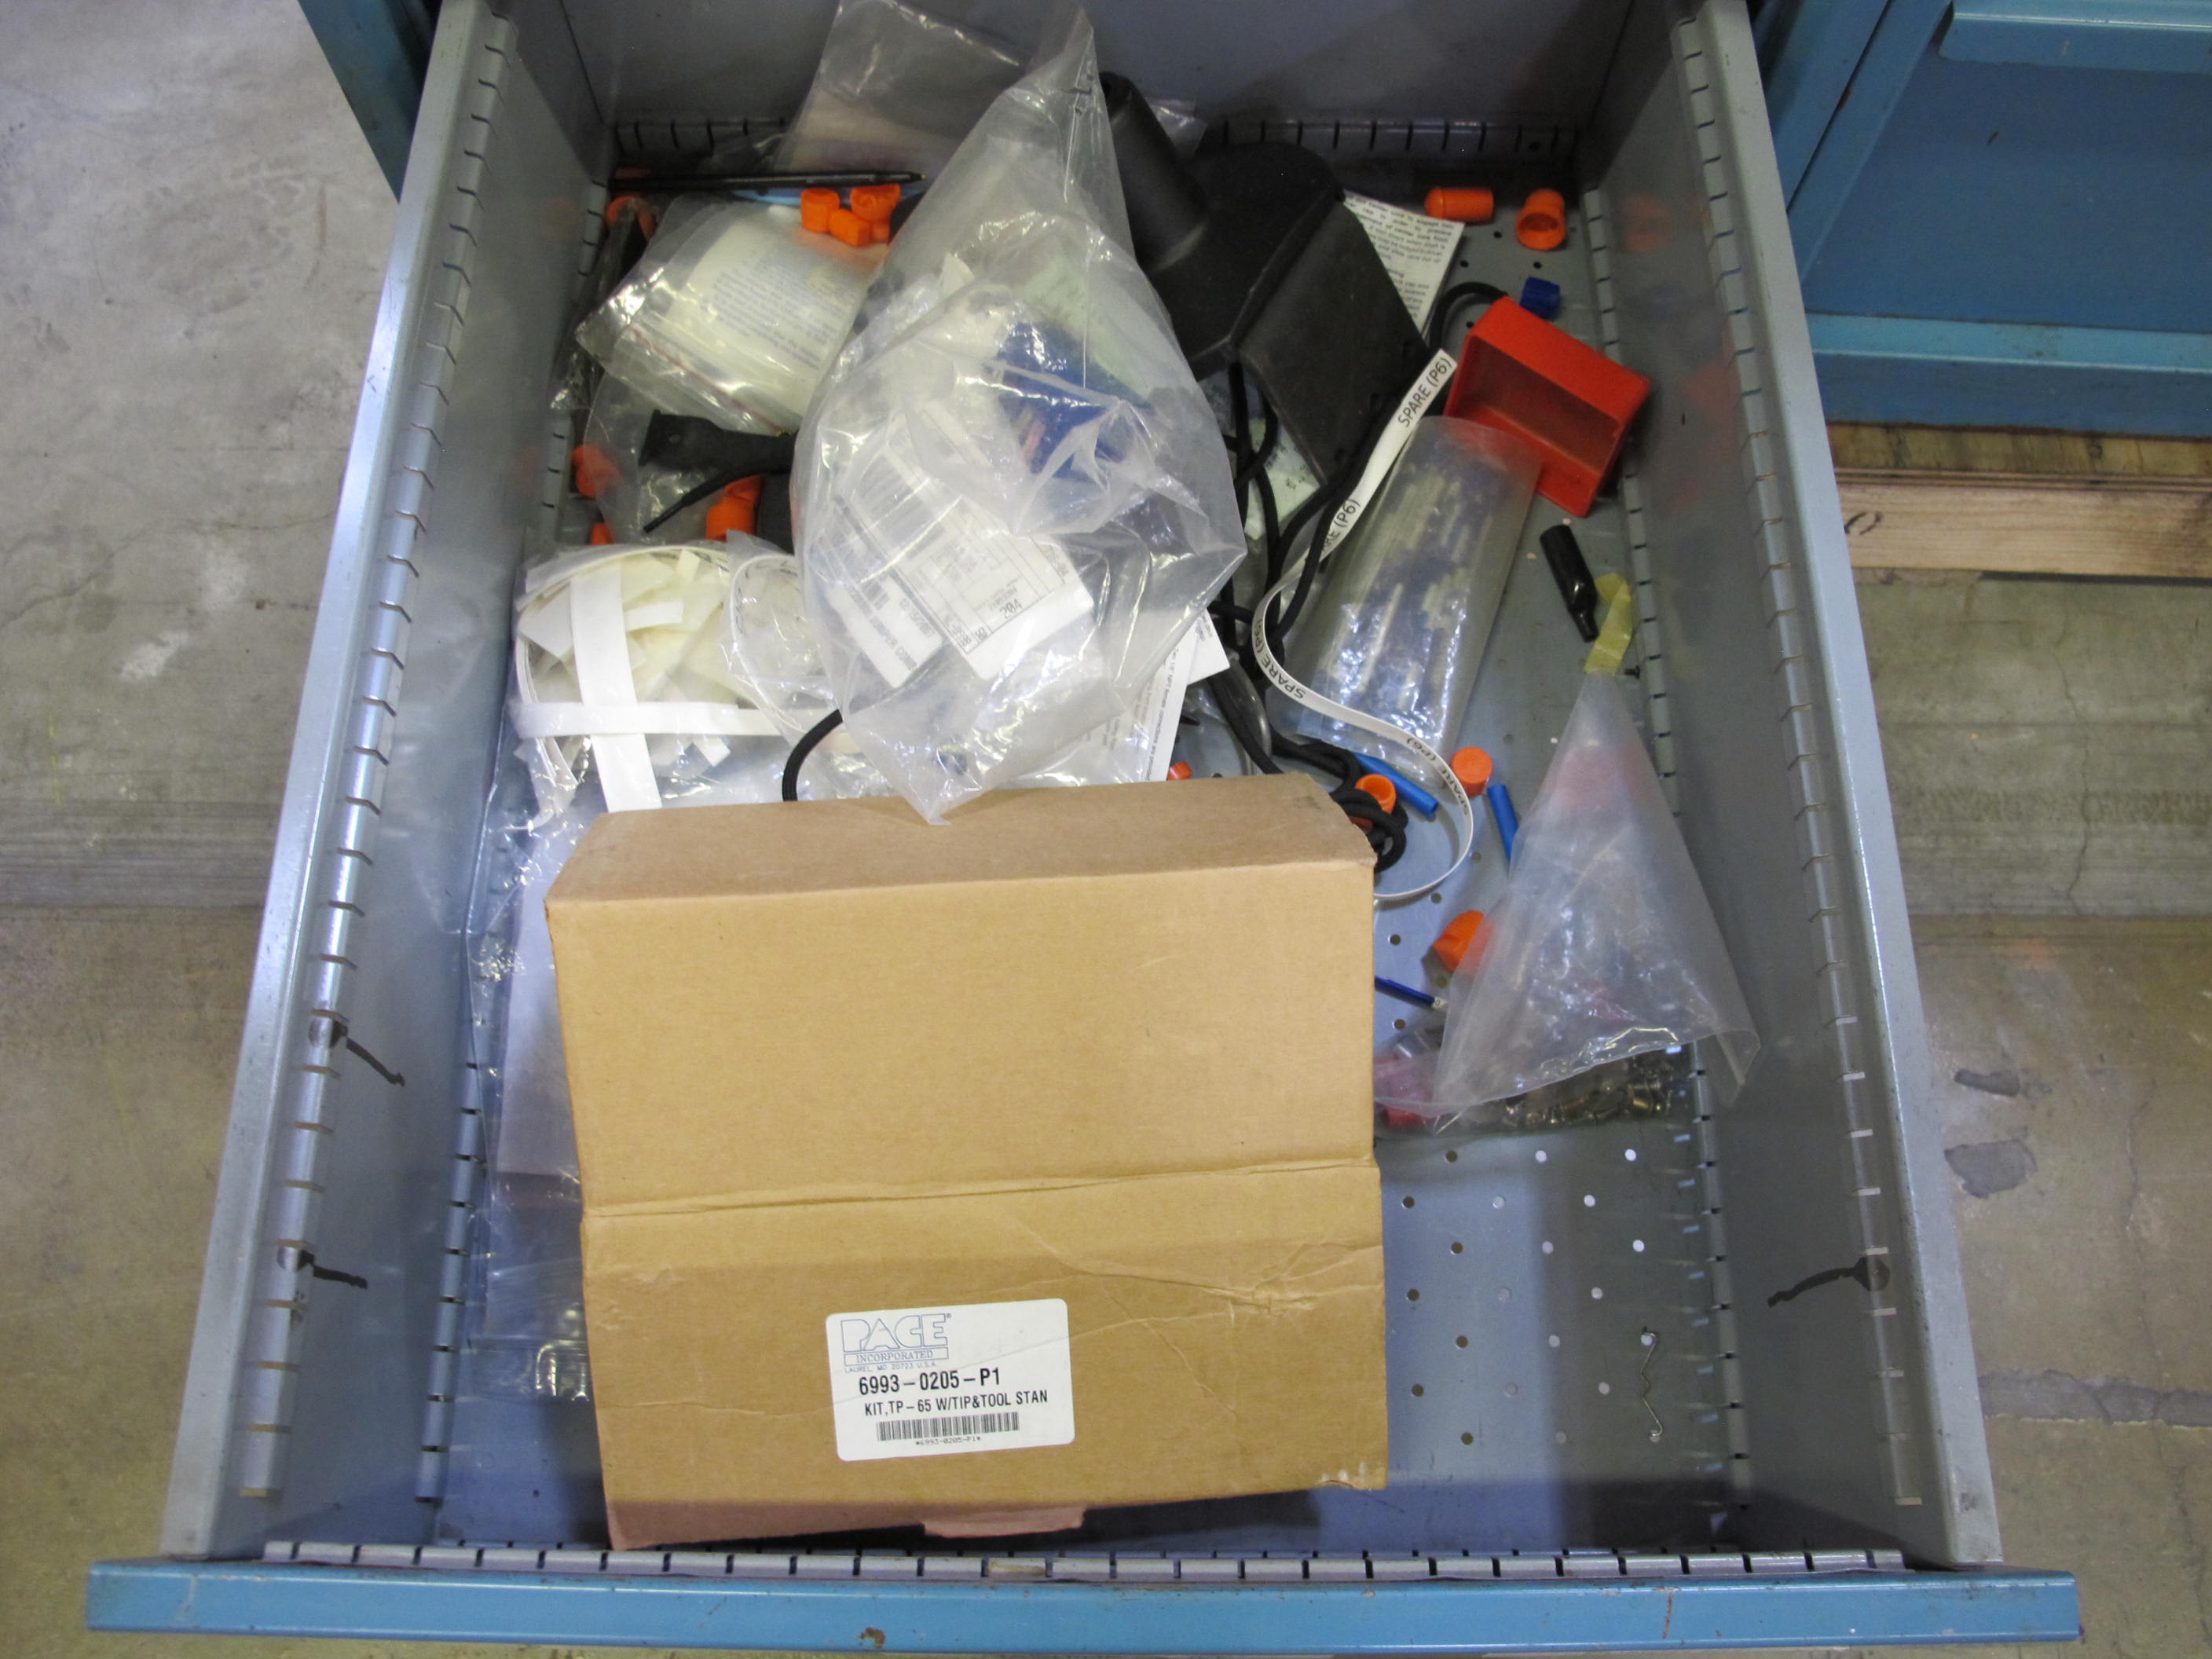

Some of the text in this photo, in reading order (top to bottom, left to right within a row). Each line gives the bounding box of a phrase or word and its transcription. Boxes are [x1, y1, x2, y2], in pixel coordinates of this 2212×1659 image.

[1397, 357, 1452, 428] SPARE (P6)
[1333, 498, 1361, 528] (P6)
[1261, 653, 1306, 698] SPARE
[1406, 737, 1469, 816] SPARE (P6)
[840, 1313, 948, 1353] PACE
[855, 1350, 933, 1364] INCORPORATED
[936, 1393, 1011, 1412] W/TIP&TOOL
[1016, 1390, 1048, 1404] STAN
